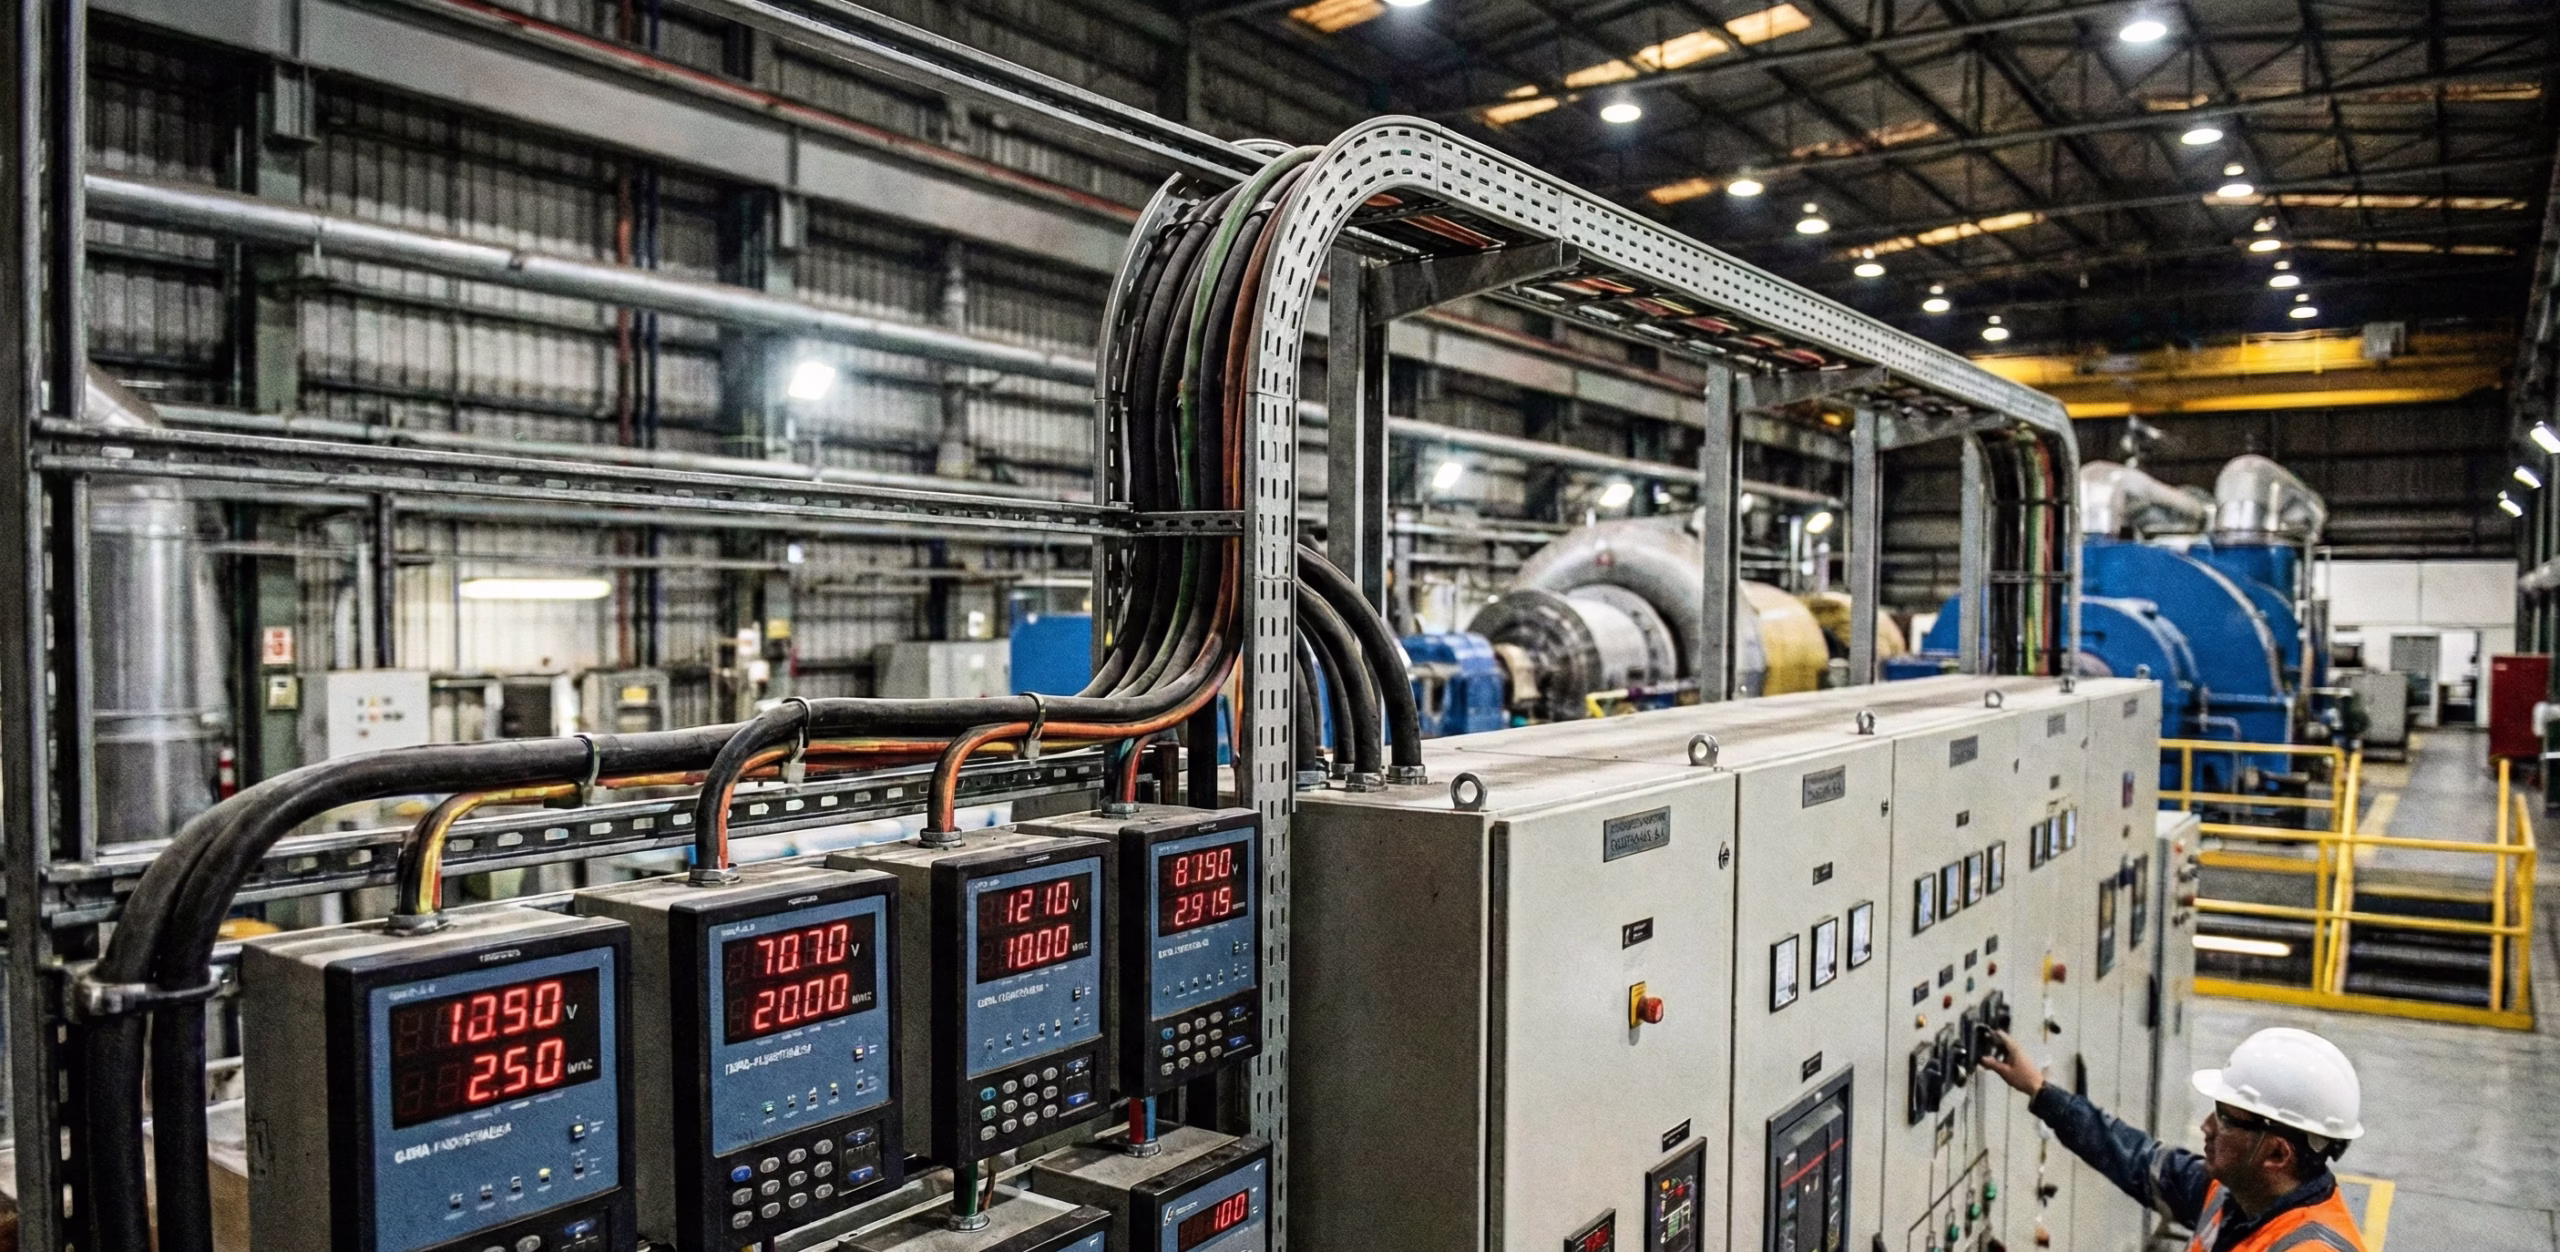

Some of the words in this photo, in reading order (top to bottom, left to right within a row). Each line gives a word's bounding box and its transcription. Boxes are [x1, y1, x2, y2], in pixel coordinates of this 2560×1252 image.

[1231, 863, 1239, 876] V
[1071, 898, 1080, 911] V
[757, 923, 848, 976] 70.70
[850, 942, 860, 957] V
[1007, 924, 1071, 969] 10.00
[565, 1002, 578, 1020] V
[754, 972, 848, 1031] 20.00
[468, 1037, 563, 1102] 2.50
[1214, 1192, 1246, 1230] 100
